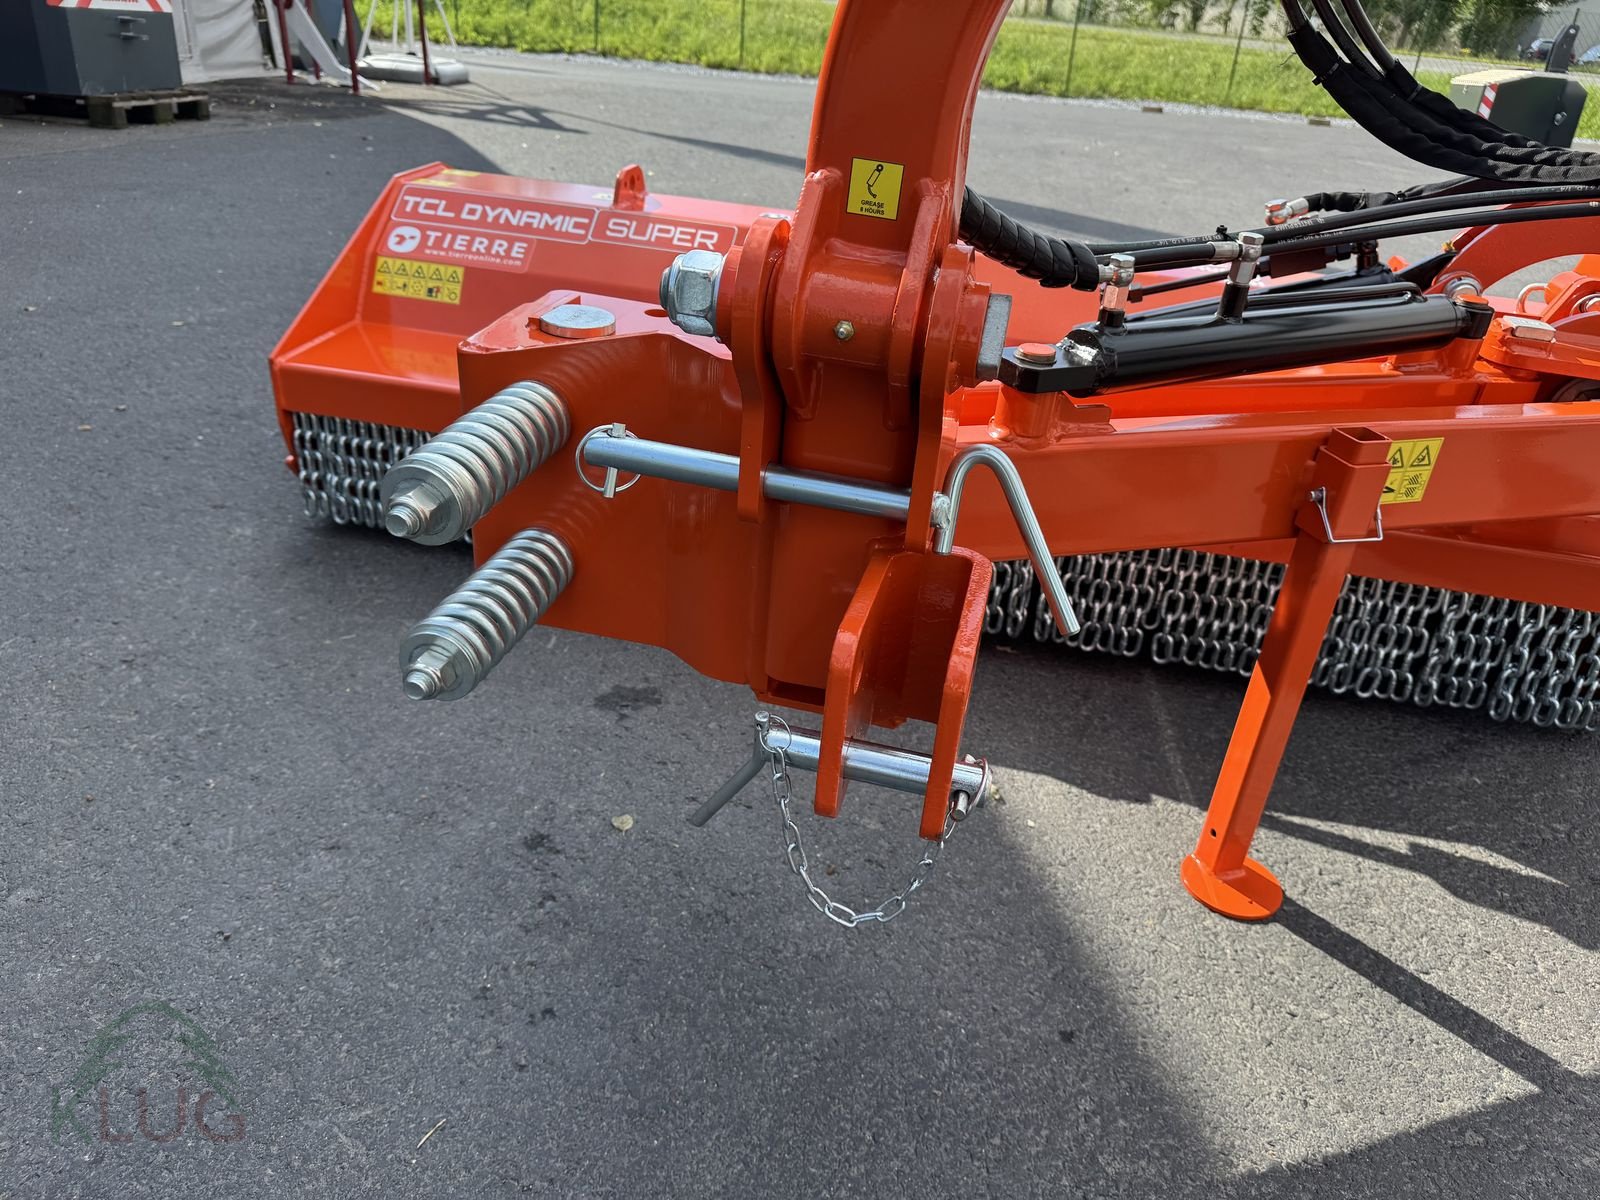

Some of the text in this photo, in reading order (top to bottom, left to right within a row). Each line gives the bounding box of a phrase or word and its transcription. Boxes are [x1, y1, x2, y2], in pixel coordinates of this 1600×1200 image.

[403, 195, 590, 235] TCL DYNAMIC
[861, 200, 885, 209] GREASE
[865, 207, 885, 215] HOURS
[426, 230, 528, 259] TIERRE
[606, 218, 719, 250] SUPER
[424, 249, 523, 267] www.tierreonline.com
